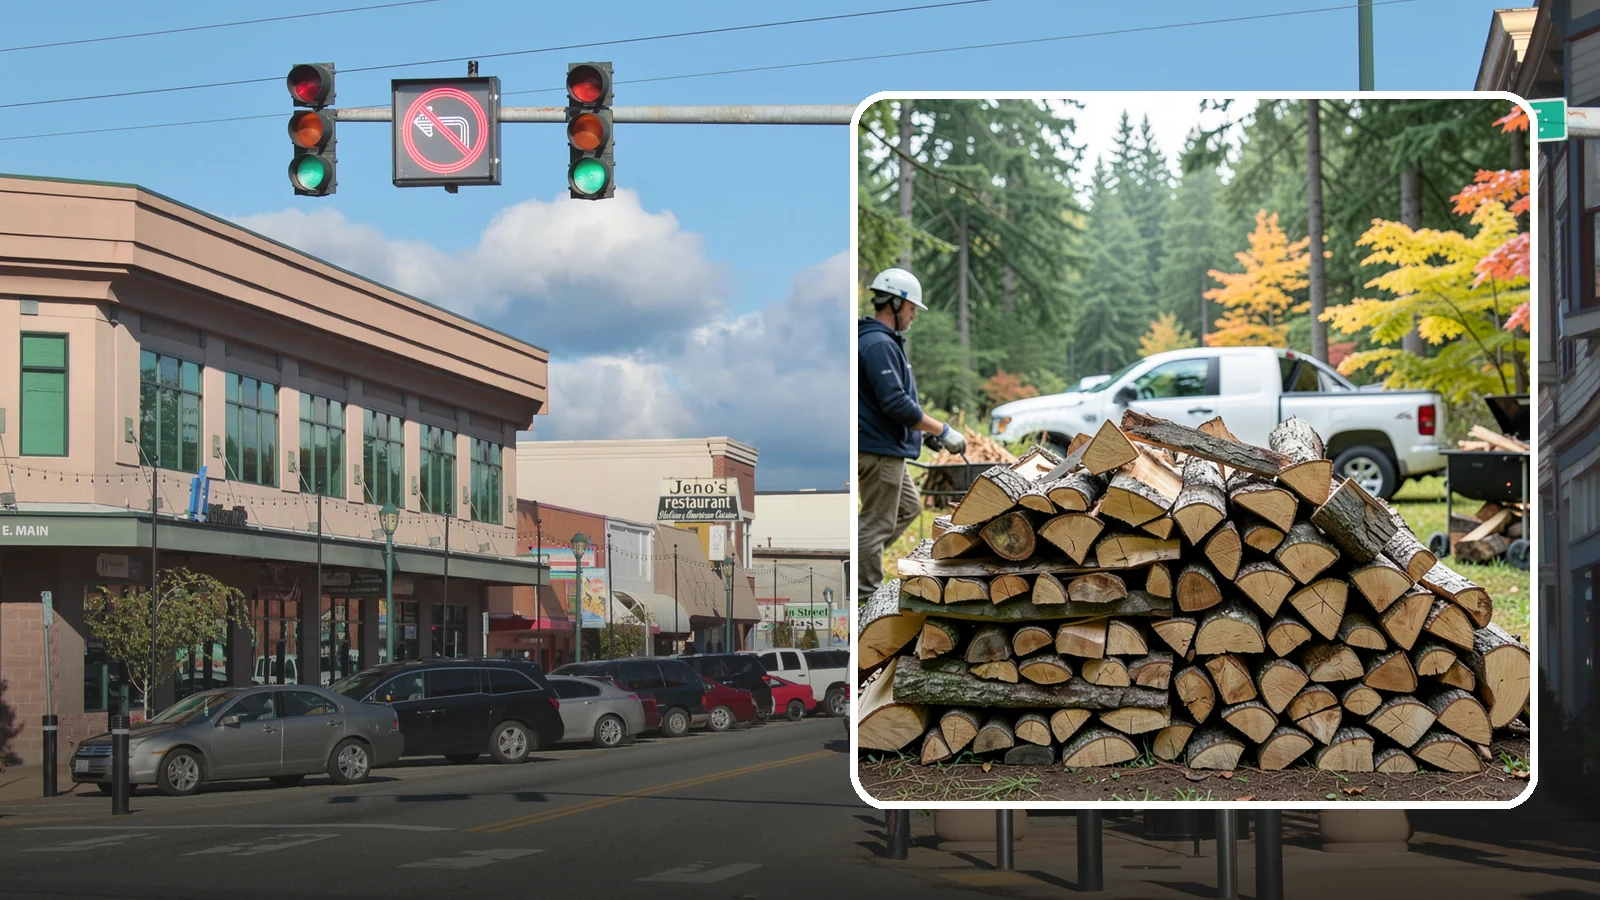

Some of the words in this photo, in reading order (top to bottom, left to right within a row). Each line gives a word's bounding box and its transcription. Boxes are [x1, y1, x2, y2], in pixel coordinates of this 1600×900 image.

[669, 480, 728, 495] Jeno's
[665, 496, 731, 509] restaurant
[658, 509, 682, 520] Italian
[686, 509, 714, 520] American
[714, 509, 738, 520] Cuisine
[2, 525, 13, 536] E.
[15, 525, 49, 536] MAIN
[797, 607, 828, 617] Street
